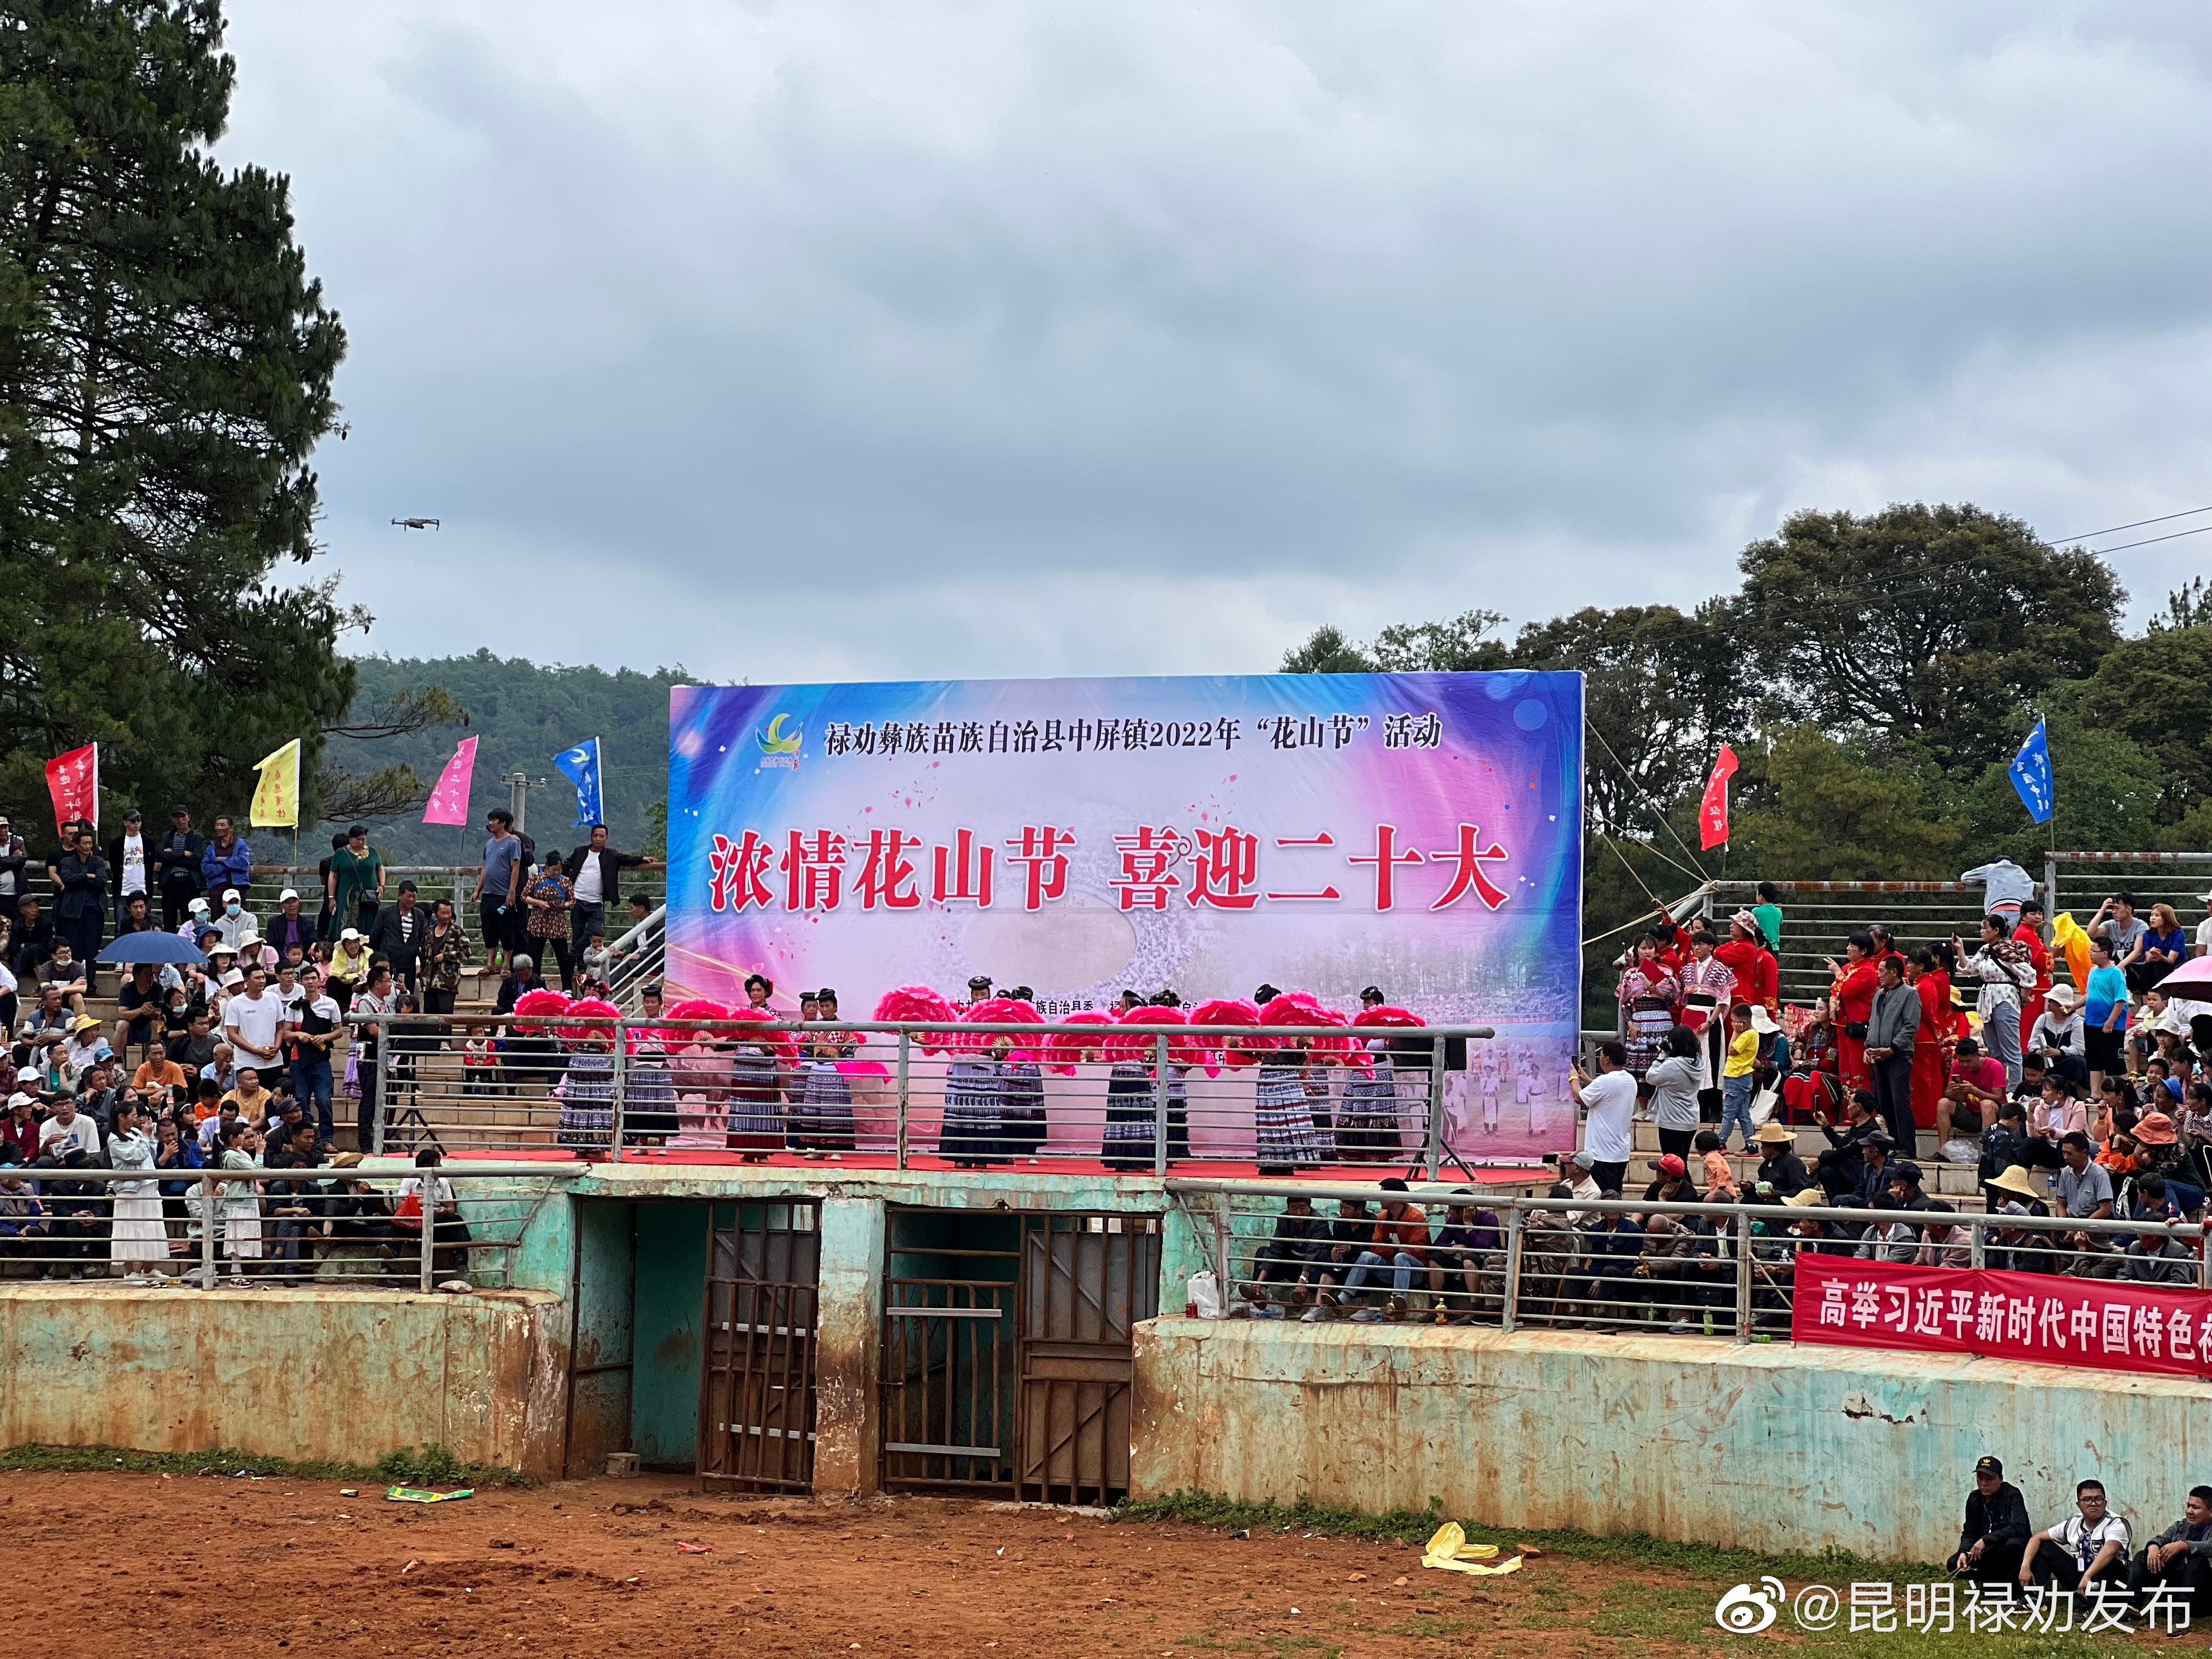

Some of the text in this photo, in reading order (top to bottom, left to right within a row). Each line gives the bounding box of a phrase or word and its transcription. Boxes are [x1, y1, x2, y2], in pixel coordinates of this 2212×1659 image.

[709, 824, 1510, 912] 浓情花山节 喜迎二十大
